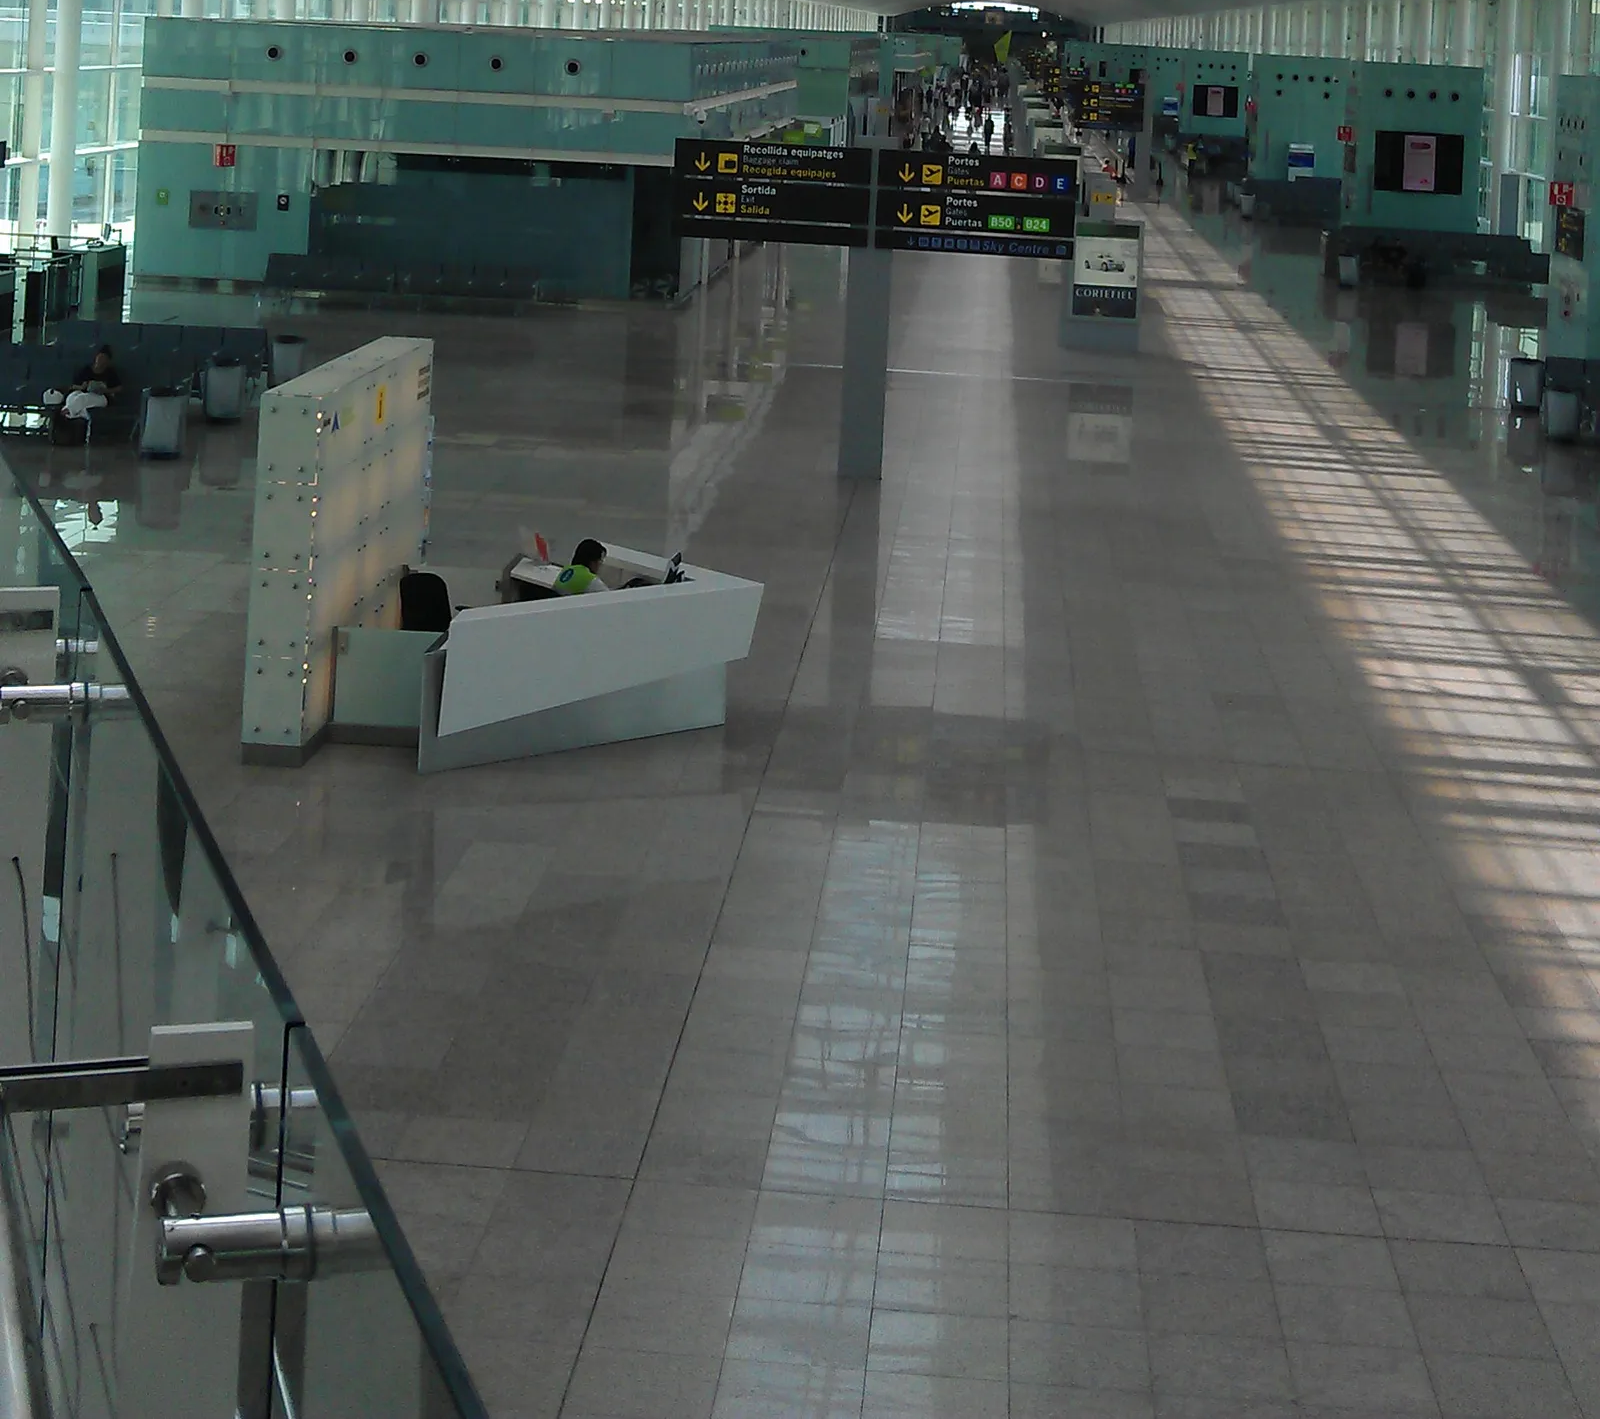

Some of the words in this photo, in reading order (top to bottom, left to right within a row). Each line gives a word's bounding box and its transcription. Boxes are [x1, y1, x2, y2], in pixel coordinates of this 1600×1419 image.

[743, 144, 788, 156] Recollida
[791, 148, 844, 160] equipatges
[948, 156, 980, 166] Portes
[743, 165, 788, 176] Recogida
[791, 168, 836, 179] equipajes
[947, 167, 970, 175] Gates
[947, 176, 985, 186] Puertas
[993, 174, 1002, 186] A
[1014, 176, 1023, 187] C
[1035, 177, 1044, 188] D
[1056, 178, 1065, 190] E
[741, 184, 776, 195] Sortida
[946, 196, 978, 207] Portes
[740, 205, 770, 215] Salida
[945, 207, 968, 216] Gates
[945, 217, 982, 227] Puertas
[990, 217, 1013, 228] B50
[1025, 219, 1047, 230] B24
[982, 241, 1004, 253] Sky
[1009, 242, 1050, 255] Centre
